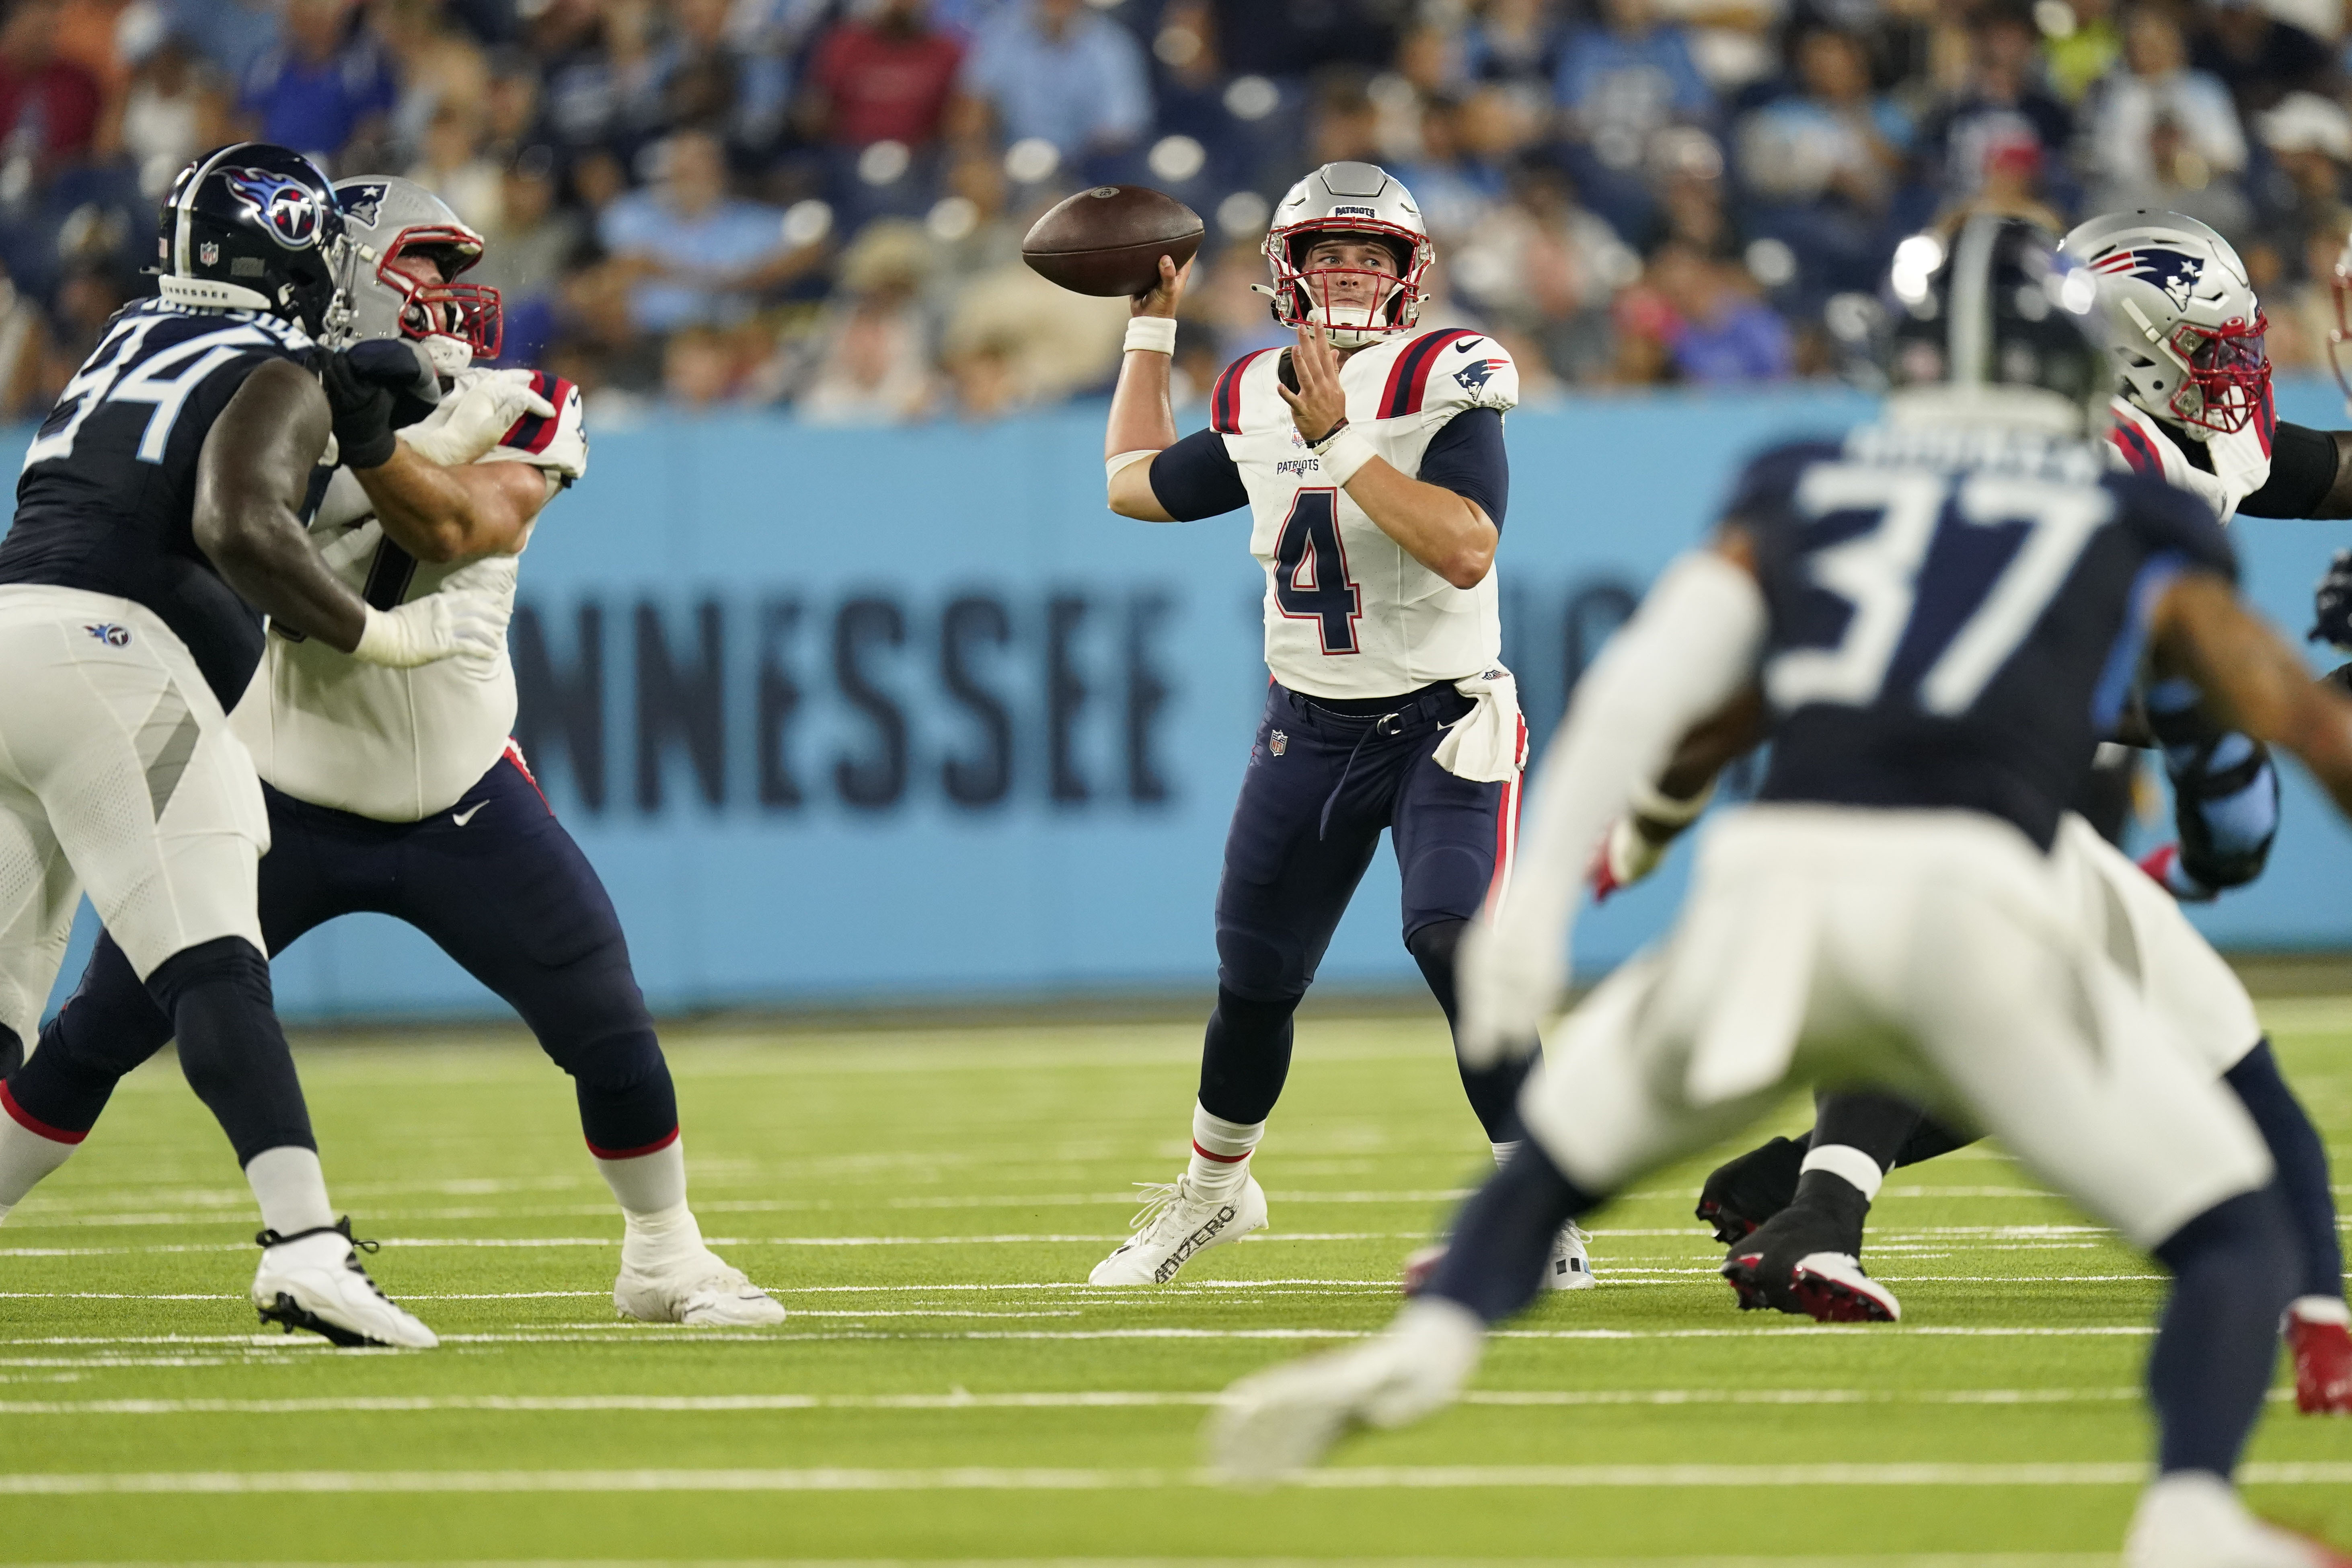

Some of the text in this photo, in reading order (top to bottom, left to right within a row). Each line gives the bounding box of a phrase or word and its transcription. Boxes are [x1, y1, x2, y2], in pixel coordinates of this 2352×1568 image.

[1335, 207, 1375, 218] PATRIOTS
[22, 315, 275, 474] 94
[1277, 459, 1319, 475] PATRIOTS
[1274, 487, 1362, 656] 4
[1766, 462, 2116, 718] 37
[1272, 740, 1283, 752] NFL
